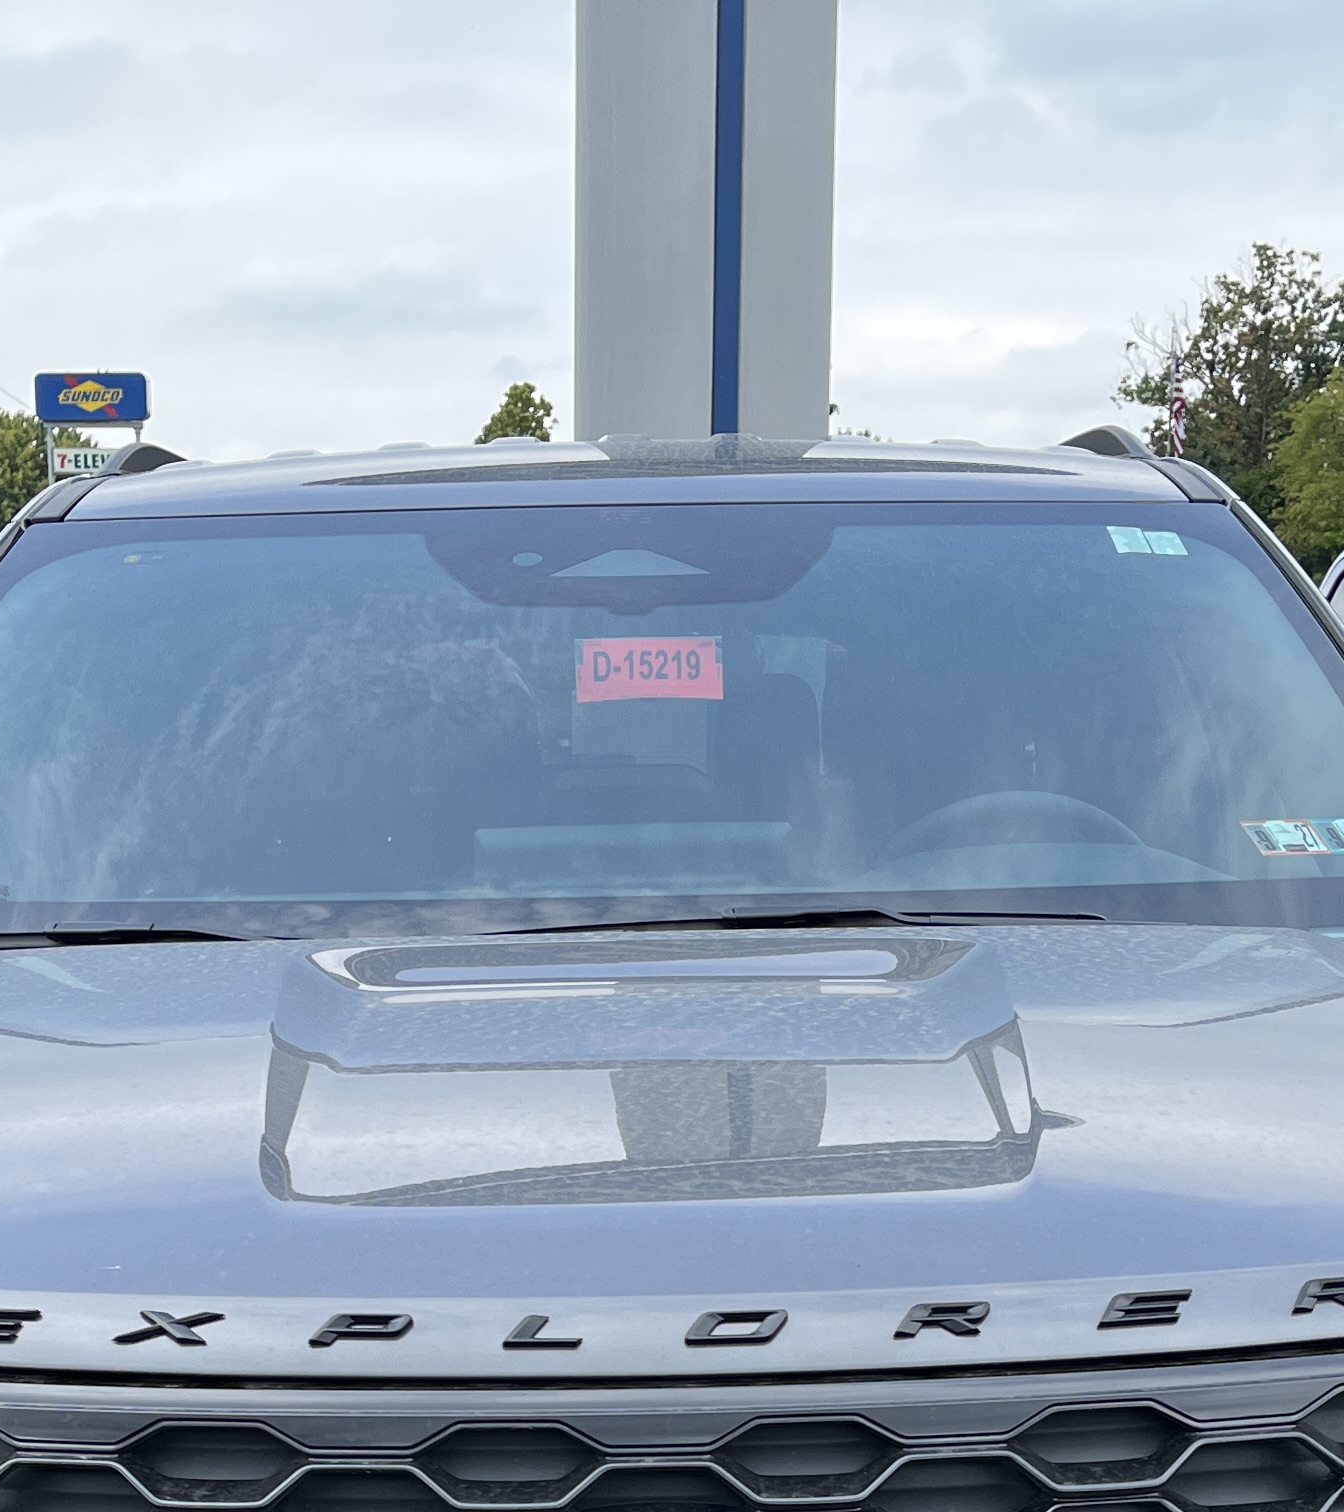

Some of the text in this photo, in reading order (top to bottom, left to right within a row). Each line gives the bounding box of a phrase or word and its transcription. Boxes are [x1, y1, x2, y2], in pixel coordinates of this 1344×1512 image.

[61, 390, 121, 402] SUNOCO
[56, 453, 111, 469] 7-ELEV
[593, 650, 701, 682] D-15219
